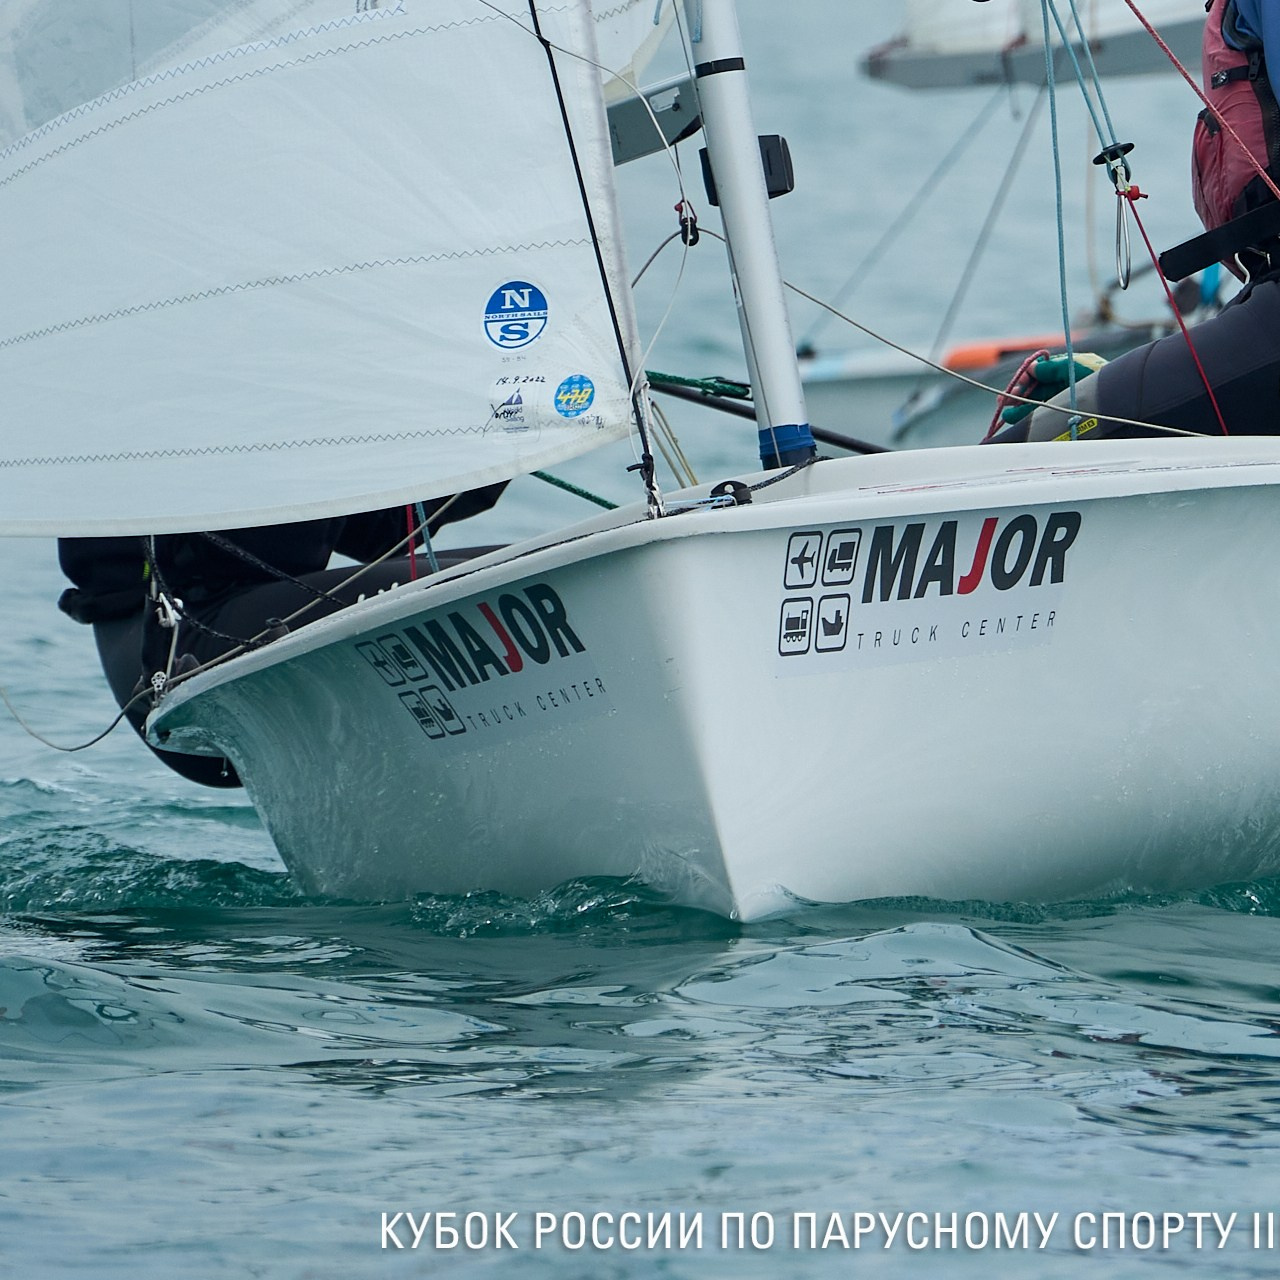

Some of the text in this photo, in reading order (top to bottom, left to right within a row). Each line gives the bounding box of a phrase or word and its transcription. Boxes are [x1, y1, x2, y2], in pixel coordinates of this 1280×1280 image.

[501, 288, 532, 309] N
[499, 322, 529, 341] S
[861, 511, 1082, 604] MAJOR
[402, 583, 586, 692] MAJOR
[857, 610, 1057, 651] TRUCK CENTER
[466, 677, 607, 731] TRUCK CENTER
